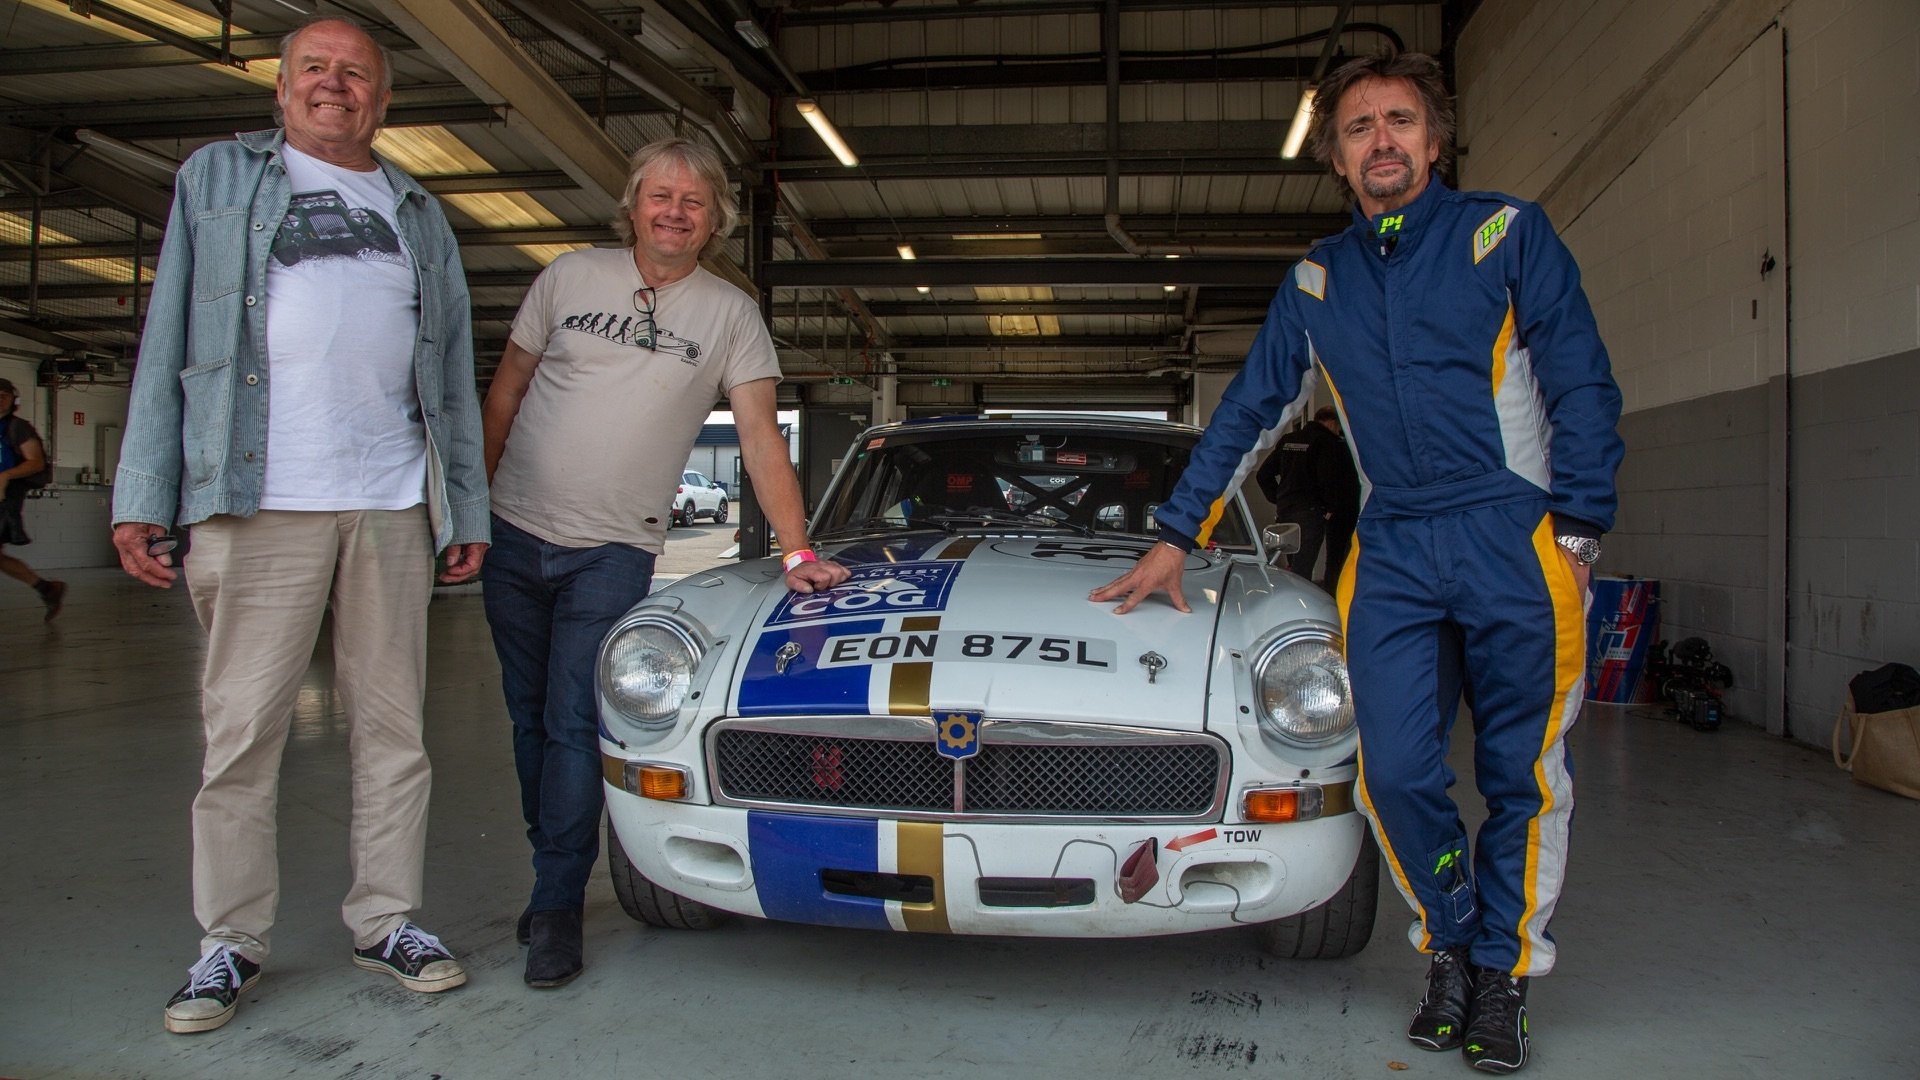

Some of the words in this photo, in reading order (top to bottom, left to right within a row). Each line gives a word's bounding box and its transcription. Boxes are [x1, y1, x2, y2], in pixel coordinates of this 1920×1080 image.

[1379, 214, 1405, 234] P1
[1480, 213, 1507, 249] P1
[946, 475, 973, 485] OMP
[789, 589, 927, 616] COG
[830, 634, 939, 663] EON
[961, 634, 1109, 668] 875L
[1223, 829, 1262, 844] TOW
